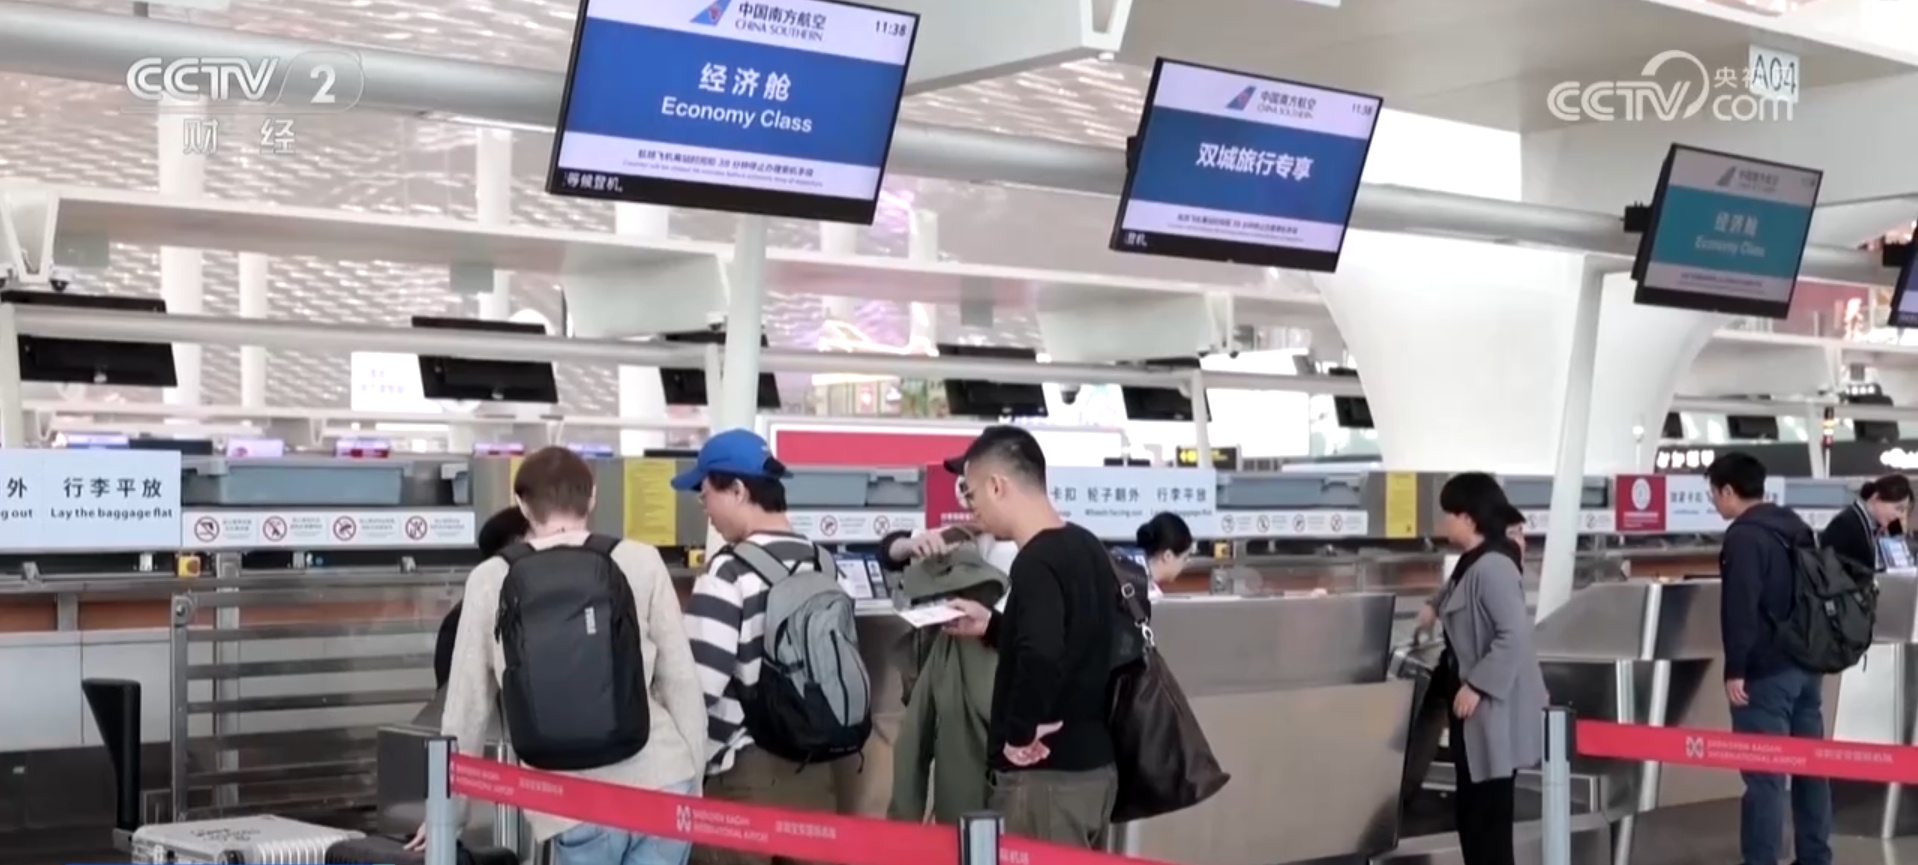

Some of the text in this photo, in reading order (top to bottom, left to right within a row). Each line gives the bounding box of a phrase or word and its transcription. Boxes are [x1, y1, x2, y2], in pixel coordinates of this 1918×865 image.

[739, 1, 827, 30] 中国南方航空
[735, 19, 823, 41] CHINA SOUTHERN
[875, 20, 907, 37] 11:38
[698, 62, 792, 102] 经济舱
[1751, 53, 1797, 95] A04
[661, 96, 813, 133] Economy Class
[1196, 142, 1314, 181] 双城旅行专享
[564, 171, 624, 193] 等候登机。
[7, 477, 162, 498] 外 行李平放
[12, 508, 33, 518] out
[51, 508, 72, 520] Lay
[75, 508, 95, 518] the
[98, 508, 151, 520] baggage
[153, 508, 172, 518] flat
